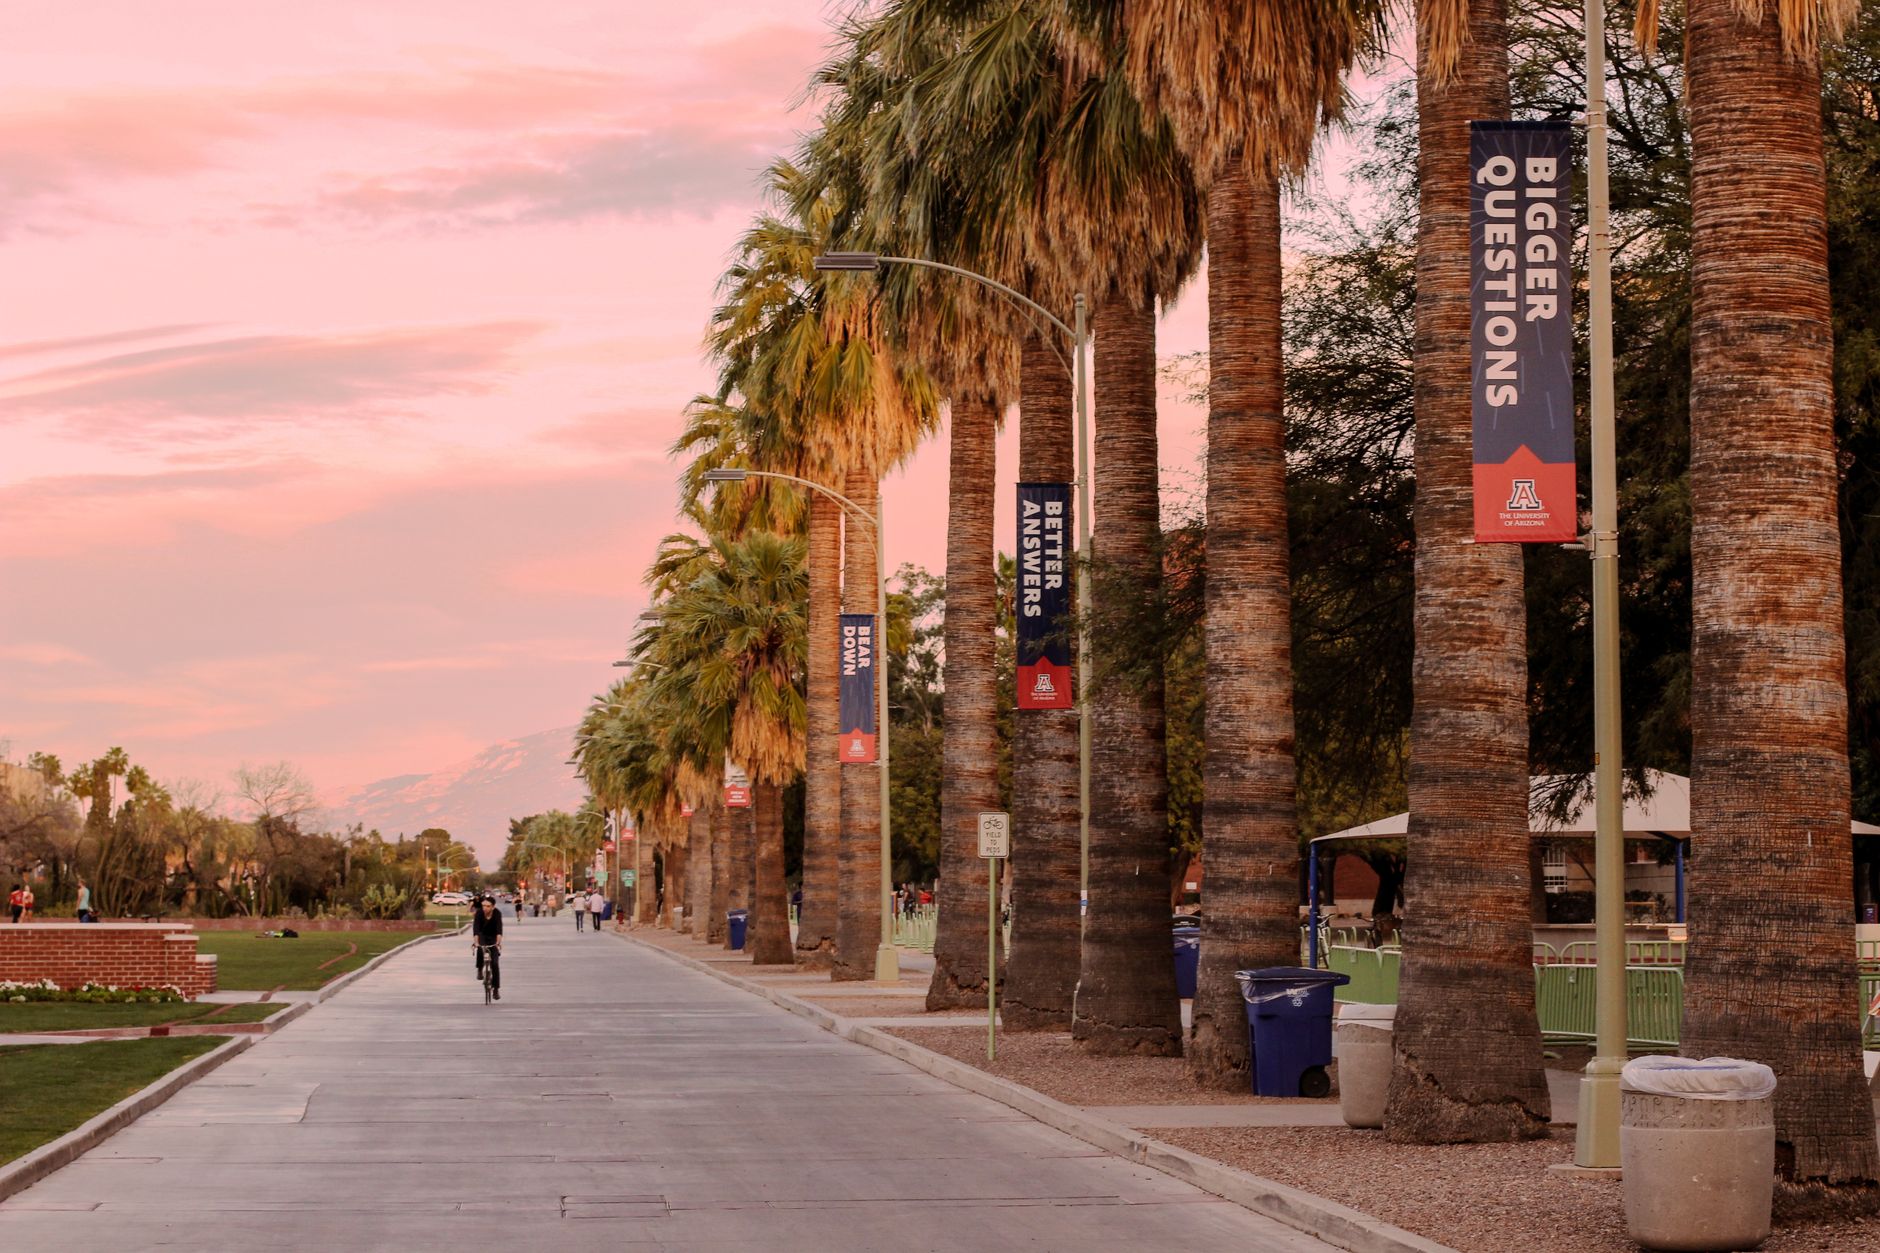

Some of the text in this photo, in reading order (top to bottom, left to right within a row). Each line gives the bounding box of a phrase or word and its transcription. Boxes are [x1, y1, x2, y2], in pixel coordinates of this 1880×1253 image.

[1476, 155, 1518, 408] QUESTIONS
[1525, 157, 1557, 322] BIGGER
[1506, 479, 1543, 511] A
[1022, 499, 1042, 618] ANSWERS
[1045, 501, 1063, 590] BETTER
[843, 626, 856, 675] DOWN
[858, 626, 870, 668] BEAR
